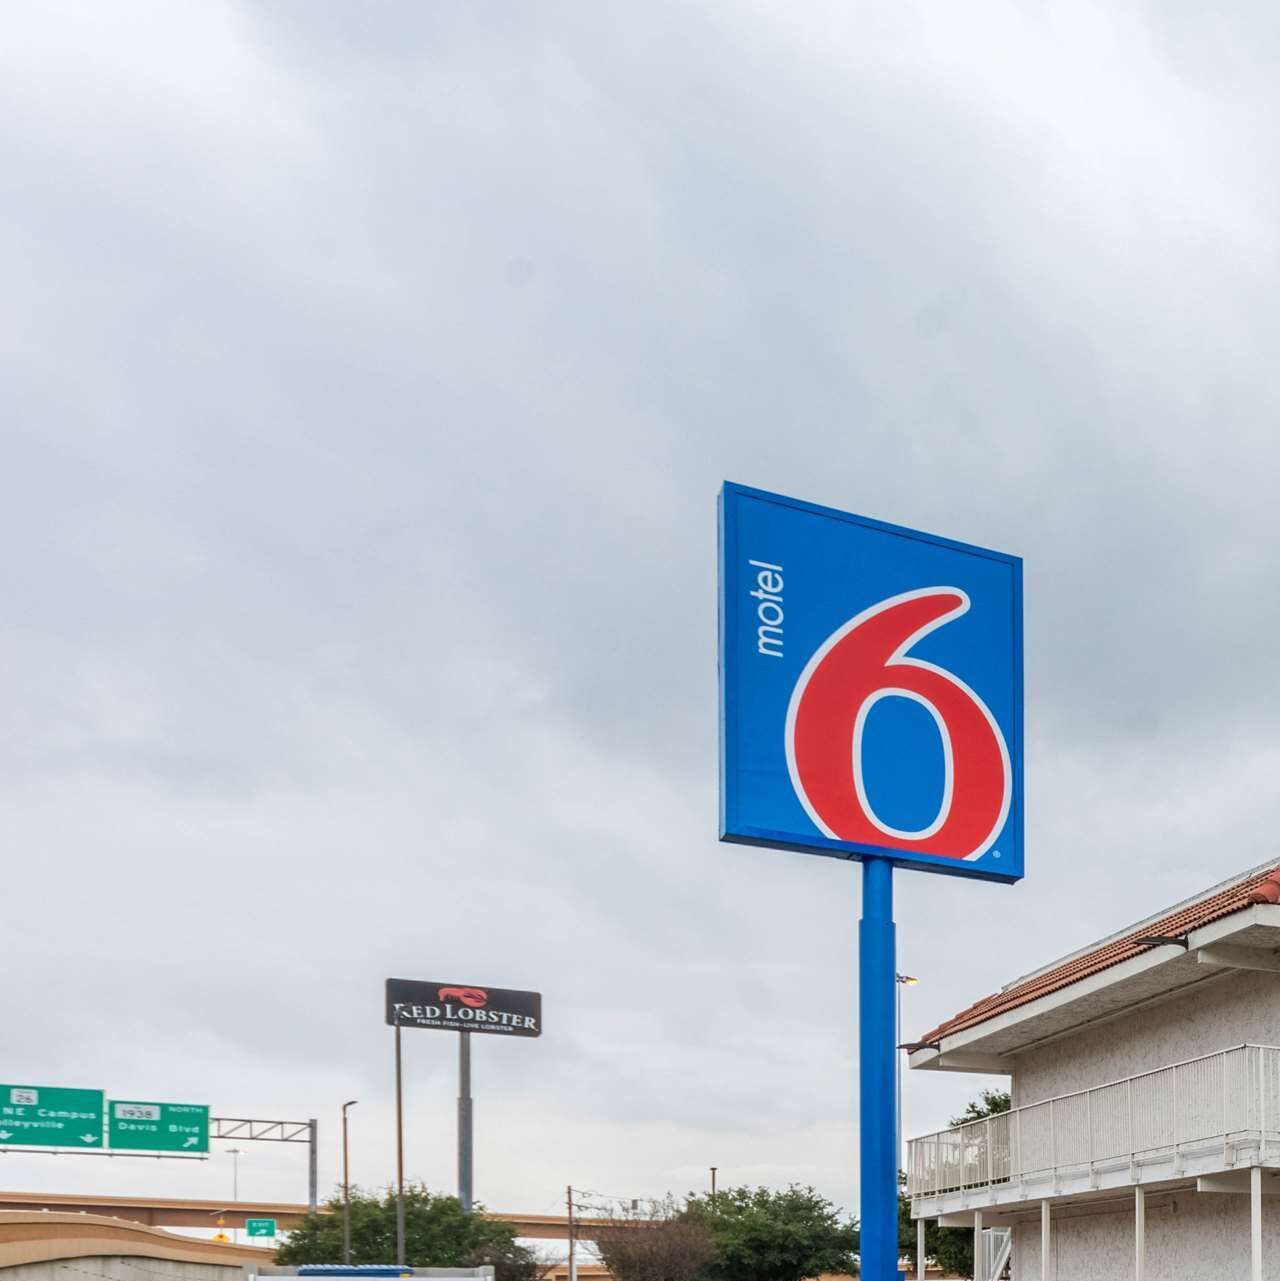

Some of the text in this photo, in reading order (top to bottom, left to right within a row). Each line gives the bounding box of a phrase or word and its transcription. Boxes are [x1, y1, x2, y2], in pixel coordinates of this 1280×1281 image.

[748, 559, 784, 658] motel
[784, 585, 1013, 862] 6
[444, 1003, 539, 1031] LOBSTER
[480, 1023, 514, 1032] LOBSTER
[15, 1094, 34, 1104] 26
[2, 1107, 97, 1120] NE Campus
[122, 1109, 153, 1119] 1938
[118, 1122, 200, 1134] Davis Blvd
